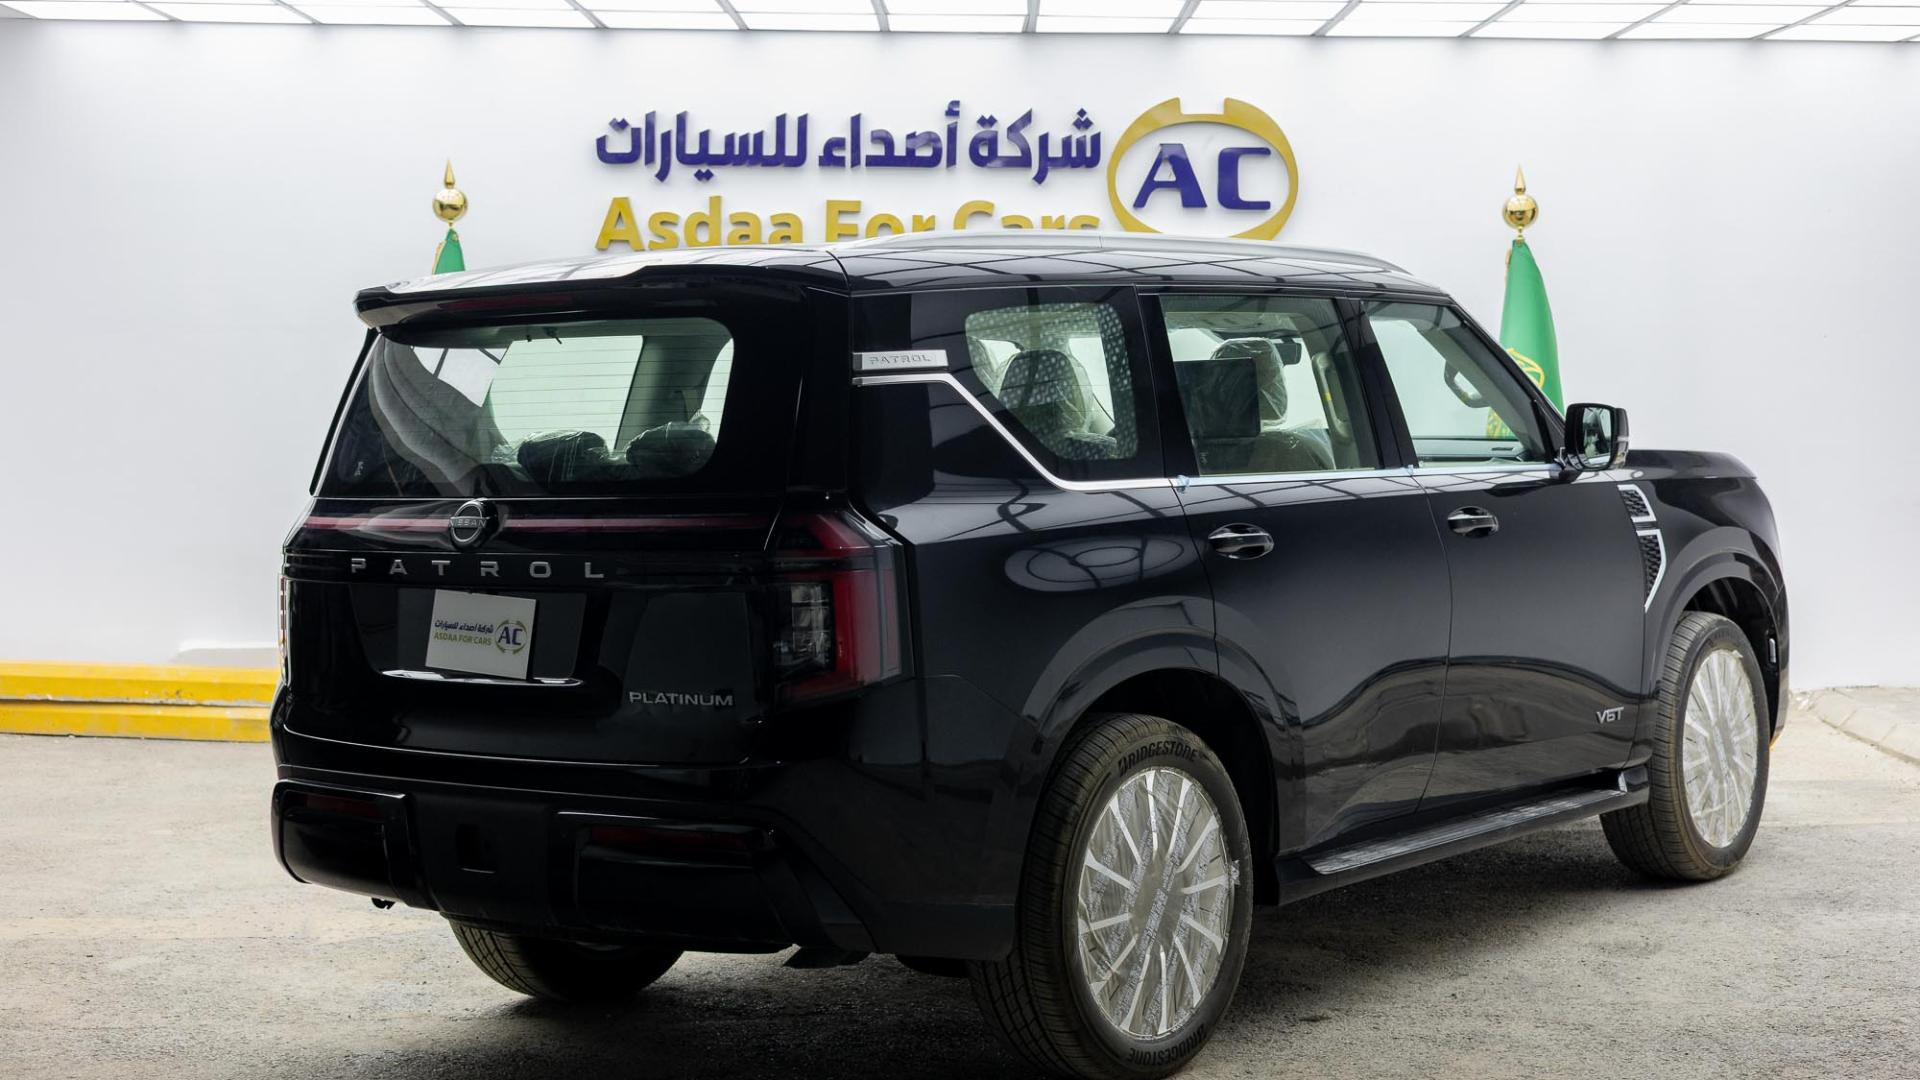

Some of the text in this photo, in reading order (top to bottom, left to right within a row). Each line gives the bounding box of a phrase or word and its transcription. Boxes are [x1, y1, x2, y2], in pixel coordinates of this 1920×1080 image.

[596, 100, 1101, 185] شركة أصداء للسيارات
[1133, 143, 1272, 210] AC
[595, 195, 804, 251] Asdaa
[869, 353, 931, 365] PATROL
[350, 557, 605, 579] PATROL
[434, 631, 493, 646] ASDAA FOR CARS
[497, 626, 523, 645] AC
[629, 691, 733, 706] PLATINUM
[1596, 706, 1625, 724] V6T
[1118, 740, 1198, 777] BRIDGESTONE
